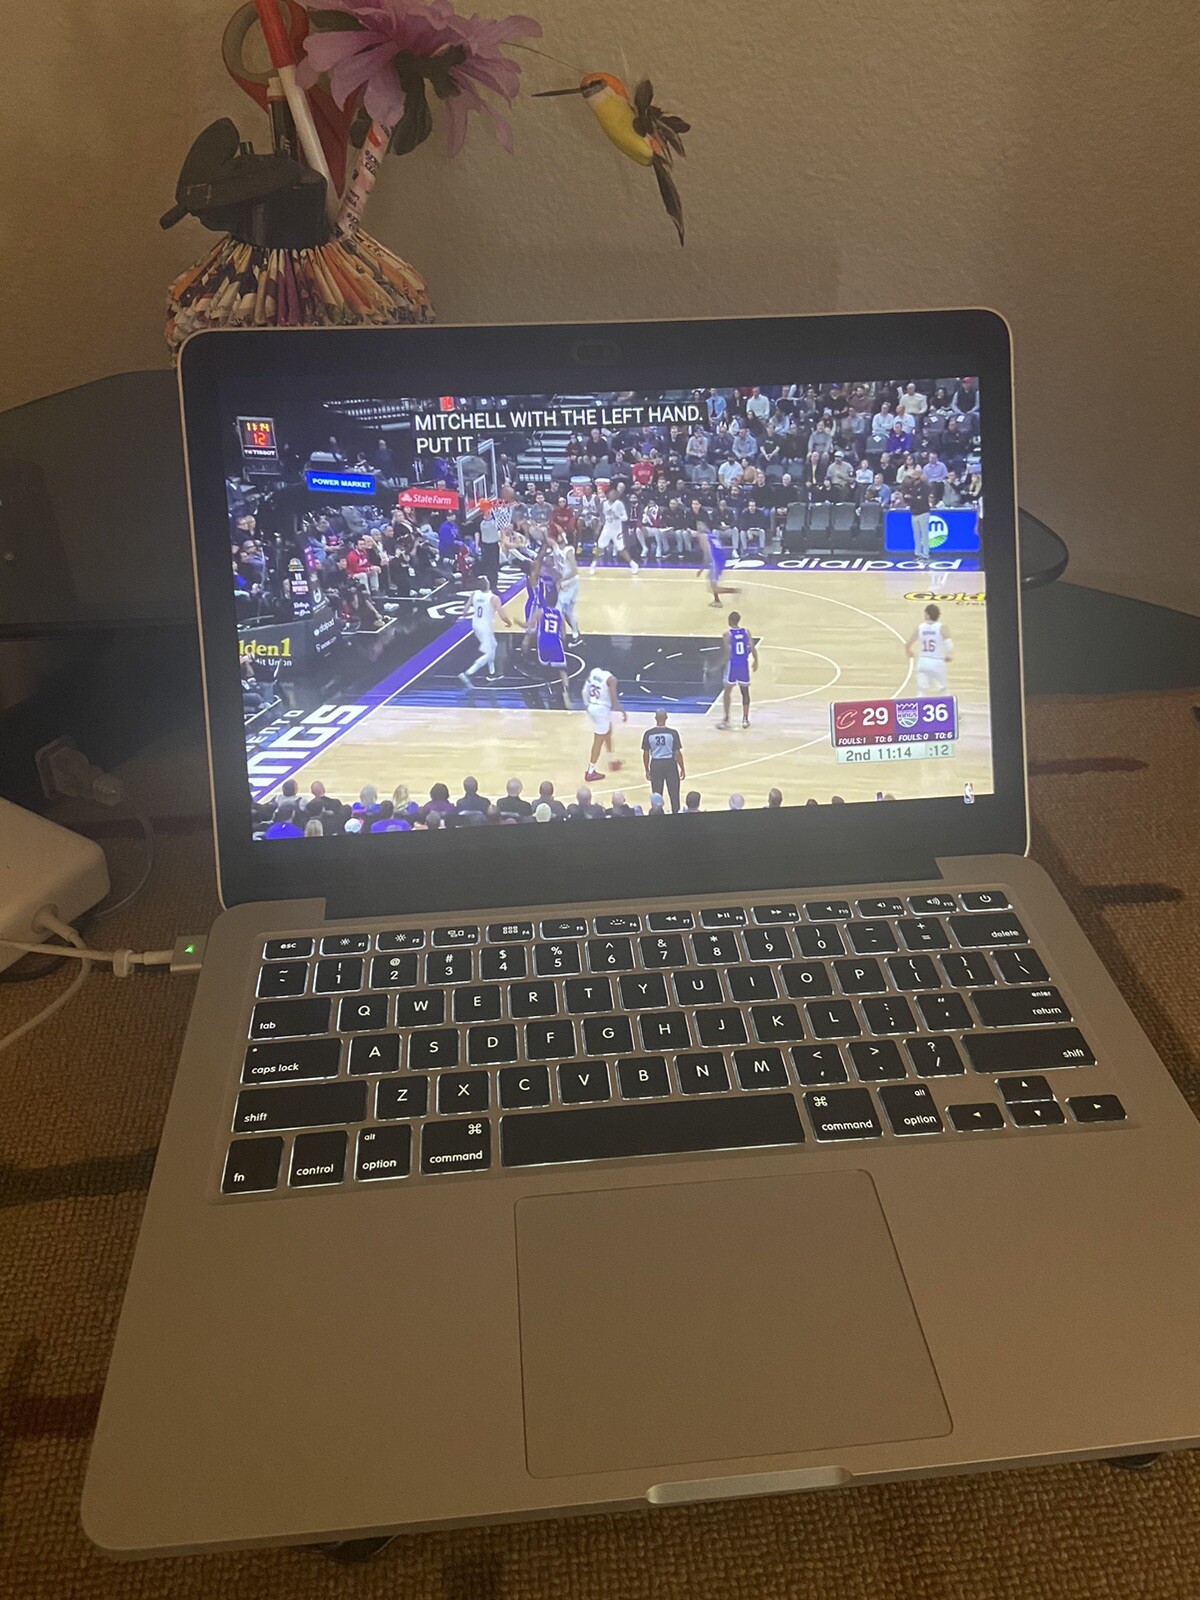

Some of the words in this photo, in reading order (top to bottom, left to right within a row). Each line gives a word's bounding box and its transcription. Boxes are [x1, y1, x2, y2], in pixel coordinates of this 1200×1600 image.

[415, 412, 506, 431] MITCHELL
[510, 410, 557, 428] WITH
[561, 409, 597, 426] THE
[601, 407, 644, 425] LEFT
[649, 405, 703, 423] HAND.
[416, 437, 453, 454] PUT
[457, 436, 473, 452] IT
[312, 478, 340, 486] POWER
[341, 480, 371, 489] MARKET
[776, 557, 962, 572] dialpad
[544, 619, 558, 633] 13
[736, 642, 744, 655] 0
[862, 707, 888, 726] 29
[922, 703, 948, 723] 36
[655, 735, 665, 746] 33
[846, 749, 871, 762] 2nd
[878, 746, 912, 759] 11:14
[658, 939, 666, 947] &
[818, 940, 826, 948] 0
[499, 950, 506, 959] $
[551, 947, 562, 955] %
[660, 951, 667, 959] 7
[713, 947, 721, 956] 8
[390, 958, 400, 966] @
[446, 954, 453, 962] #
[555, 958, 561, 967] 5
[608, 955, 615, 963] 6
[446, 967, 453, 975] 3
[499, 962, 507, 970] 4
[337, 975, 340, 983] 1
[391, 971, 398, 979] 2
[801, 973, 812, 982] O
[855, 970, 864, 979] P
[639, 984, 647, 993] Y
[693, 980, 703, 990] U
[529, 992, 538, 1002] R
[584, 988, 592, 998] T
[414, 1001, 428, 1011] W
[474, 996, 481, 1006] E
[358, 1006, 370, 1016] Q
[772, 1016, 784, 1026] K
[829, 1012, 839, 1022] L
[659, 1024, 670, 1034] H
[719, 1020, 724, 1029] J
[547, 1032, 554, 1043] F
[603, 1028, 614, 1038] G
[430, 1042, 438, 1052] S
[488, 1037, 498, 1047] D
[369, 1046, 380, 1057] A
[1063, 1049, 1084, 1057] shift
[279, 1063, 298, 1071] lock
[696, 1065, 709, 1077] N
[755, 1061, 769, 1072] M
[579, 1074, 589, 1085] V
[639, 1070, 649, 1081] B
[519, 1079, 530, 1090] C
[397, 1089, 408, 1101] Z
[458, 1084, 469, 1096] X
[245, 1113, 267, 1122] shift
[904, 1116, 936, 1126] option
[822, 1120, 873, 1130] command
[430, 1150, 482, 1163] command
[297, 1164, 333, 1175] control
[363, 1160, 396, 1170] option
[234, 1173, 244, 1181] fn
